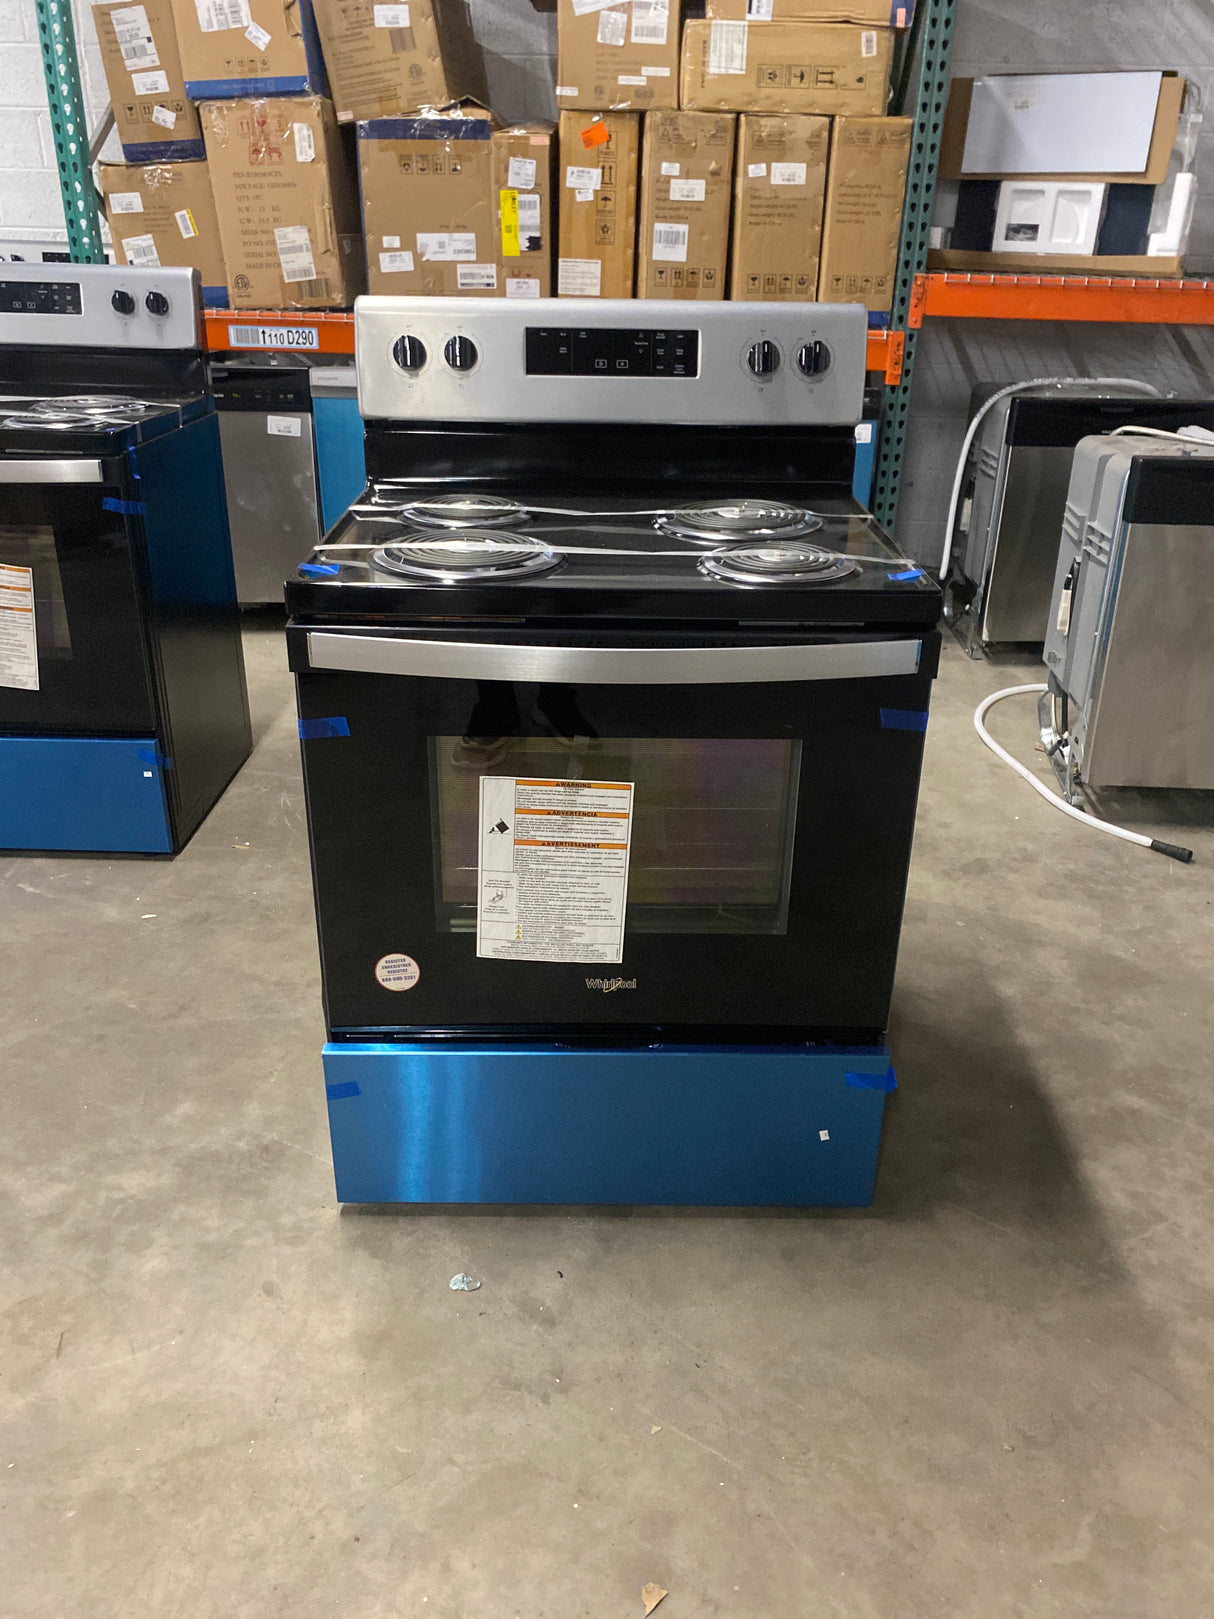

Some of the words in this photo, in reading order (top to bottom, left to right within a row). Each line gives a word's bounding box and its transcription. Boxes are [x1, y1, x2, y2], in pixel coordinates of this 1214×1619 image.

[268, 332, 285, 345] 110
[286, 330, 314, 346] D290
[552, 809, 598, 817] ADVERTENCIA
[546, 841, 600, 849] AVERTISSEMENT
[585, 976, 637, 993] Whirlpool
